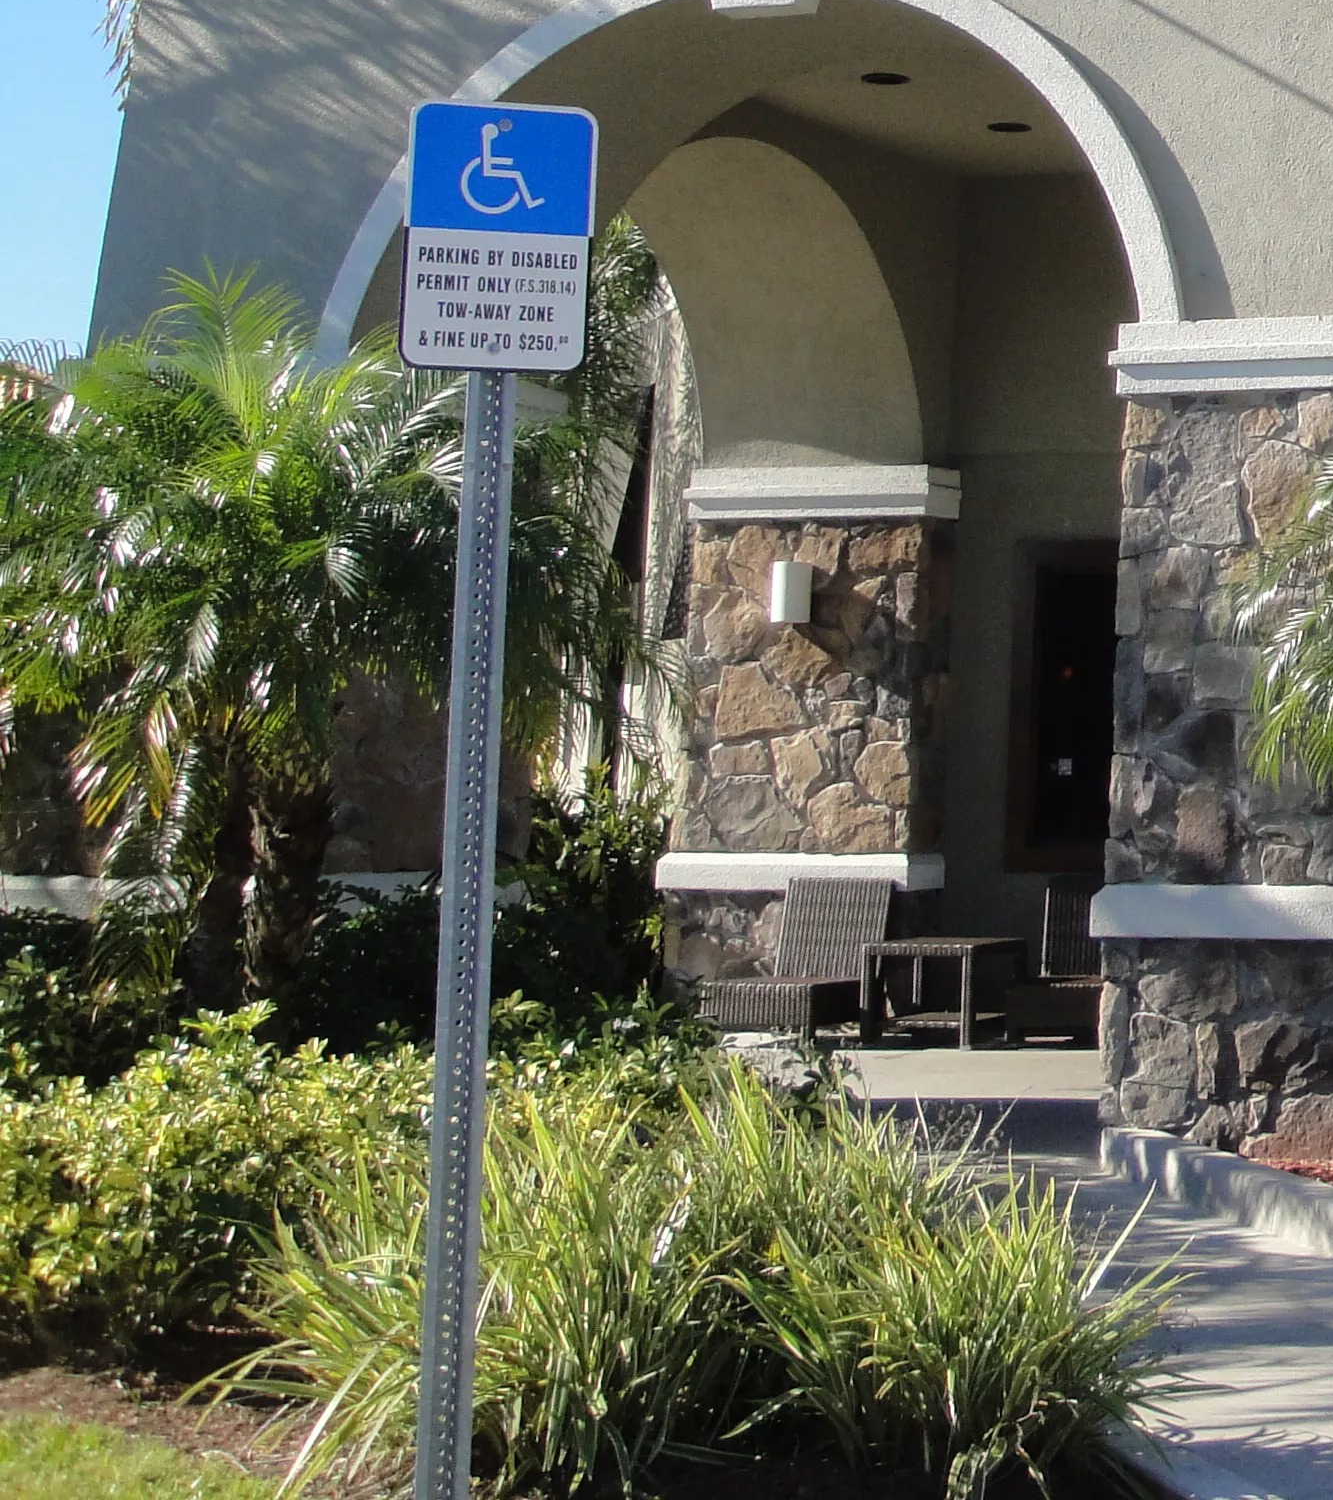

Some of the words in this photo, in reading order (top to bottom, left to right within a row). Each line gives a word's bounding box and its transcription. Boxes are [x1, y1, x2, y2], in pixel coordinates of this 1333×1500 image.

[418, 246, 480, 266] PARKING
[488, 249, 505, 267] BY
[511, 251, 578, 270] DISABLED
[416, 273, 471, 291] PERMIT
[477, 276, 512, 293] ONLY
[515, 278, 577, 296] (F.S.318.14)
[437, 301, 512, 321] TOW-AWAY
[519, 305, 555, 322] ZONE
[418, 329, 428, 346] &
[434, 330, 466, 348] FINE
[470, 332, 489, 349] UP
[494, 333, 511, 349] TO
